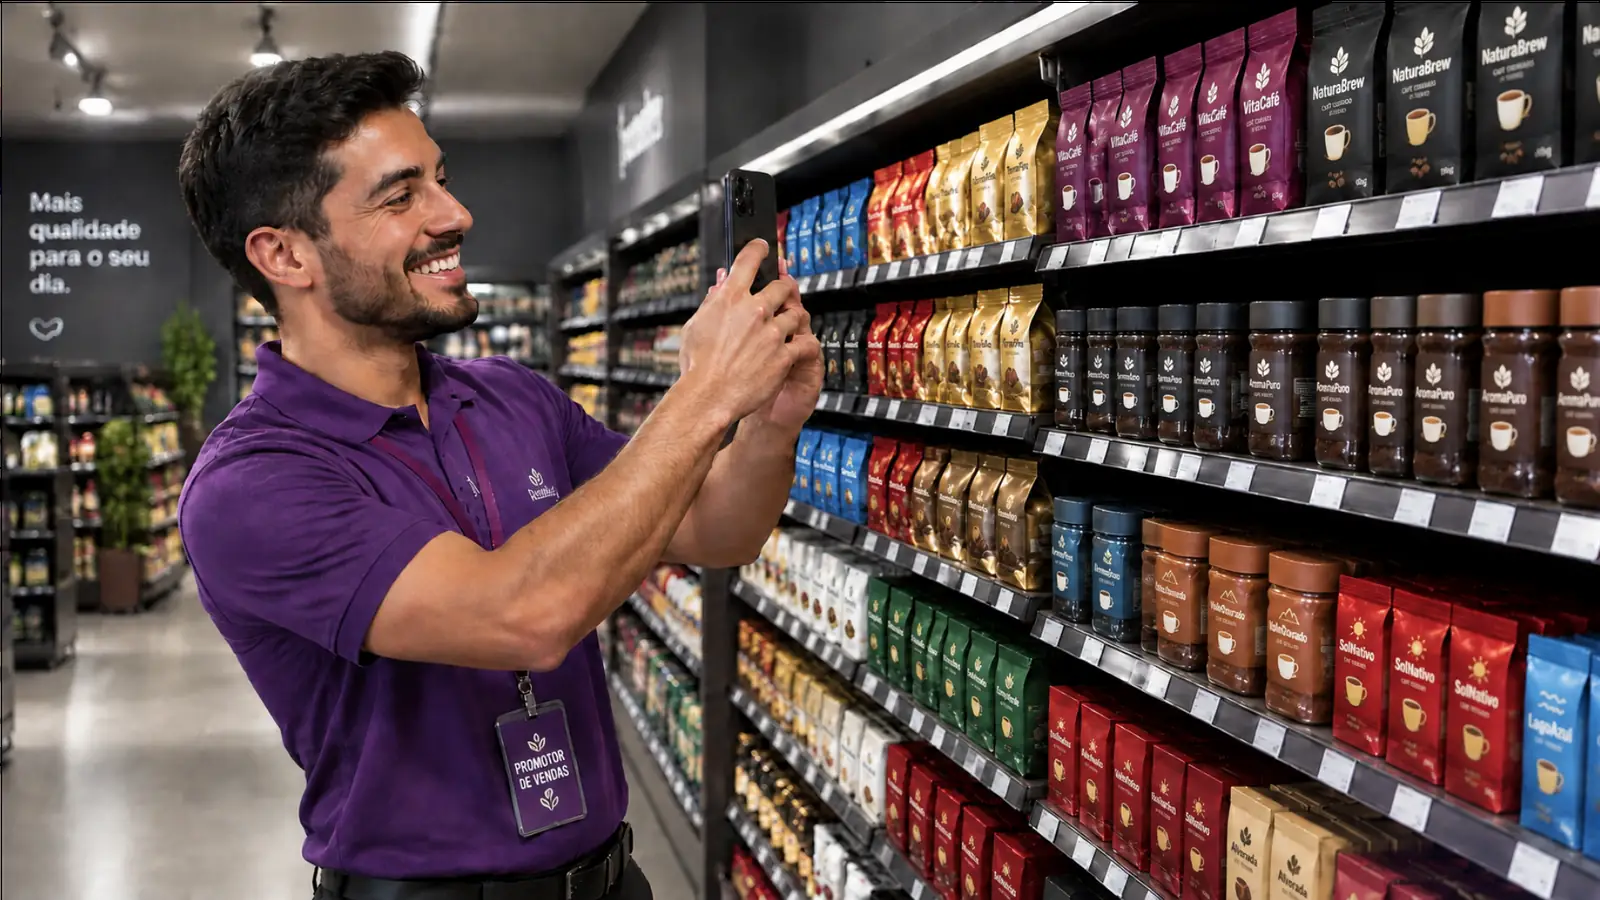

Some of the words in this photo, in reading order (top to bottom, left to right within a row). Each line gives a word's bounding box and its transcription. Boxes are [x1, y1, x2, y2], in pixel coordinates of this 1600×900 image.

[1481, 36, 1548, 66] NaturaBrew
[1392, 57, 1452, 84] NaturaBrew
[1312, 76, 1365, 101] NaturaBrew
[1243, 91, 1280, 115] VitaCafé
[29, 191, 83, 213] Mais
[28, 218, 142, 244] qualidade
[29, 249, 82, 272] para
[86, 249, 104, 267] o
[108, 249, 150, 267] seu
[29, 273, 71, 294] dia.
[1415, 386, 1455, 401] AromaPuro
[1482, 388, 1527, 405] AromaPuro
[1339, 638, 1375, 662] SolNativo
[1394, 657, 1435, 684] SolNativo
[1454, 679, 1499, 709] SolNativo
[1528, 712, 1573, 744] LagoAzul
[514, 749, 566, 775] PROMOTOR
[519, 776, 533, 790] DE
[532, 765, 570, 786] VENDAS
